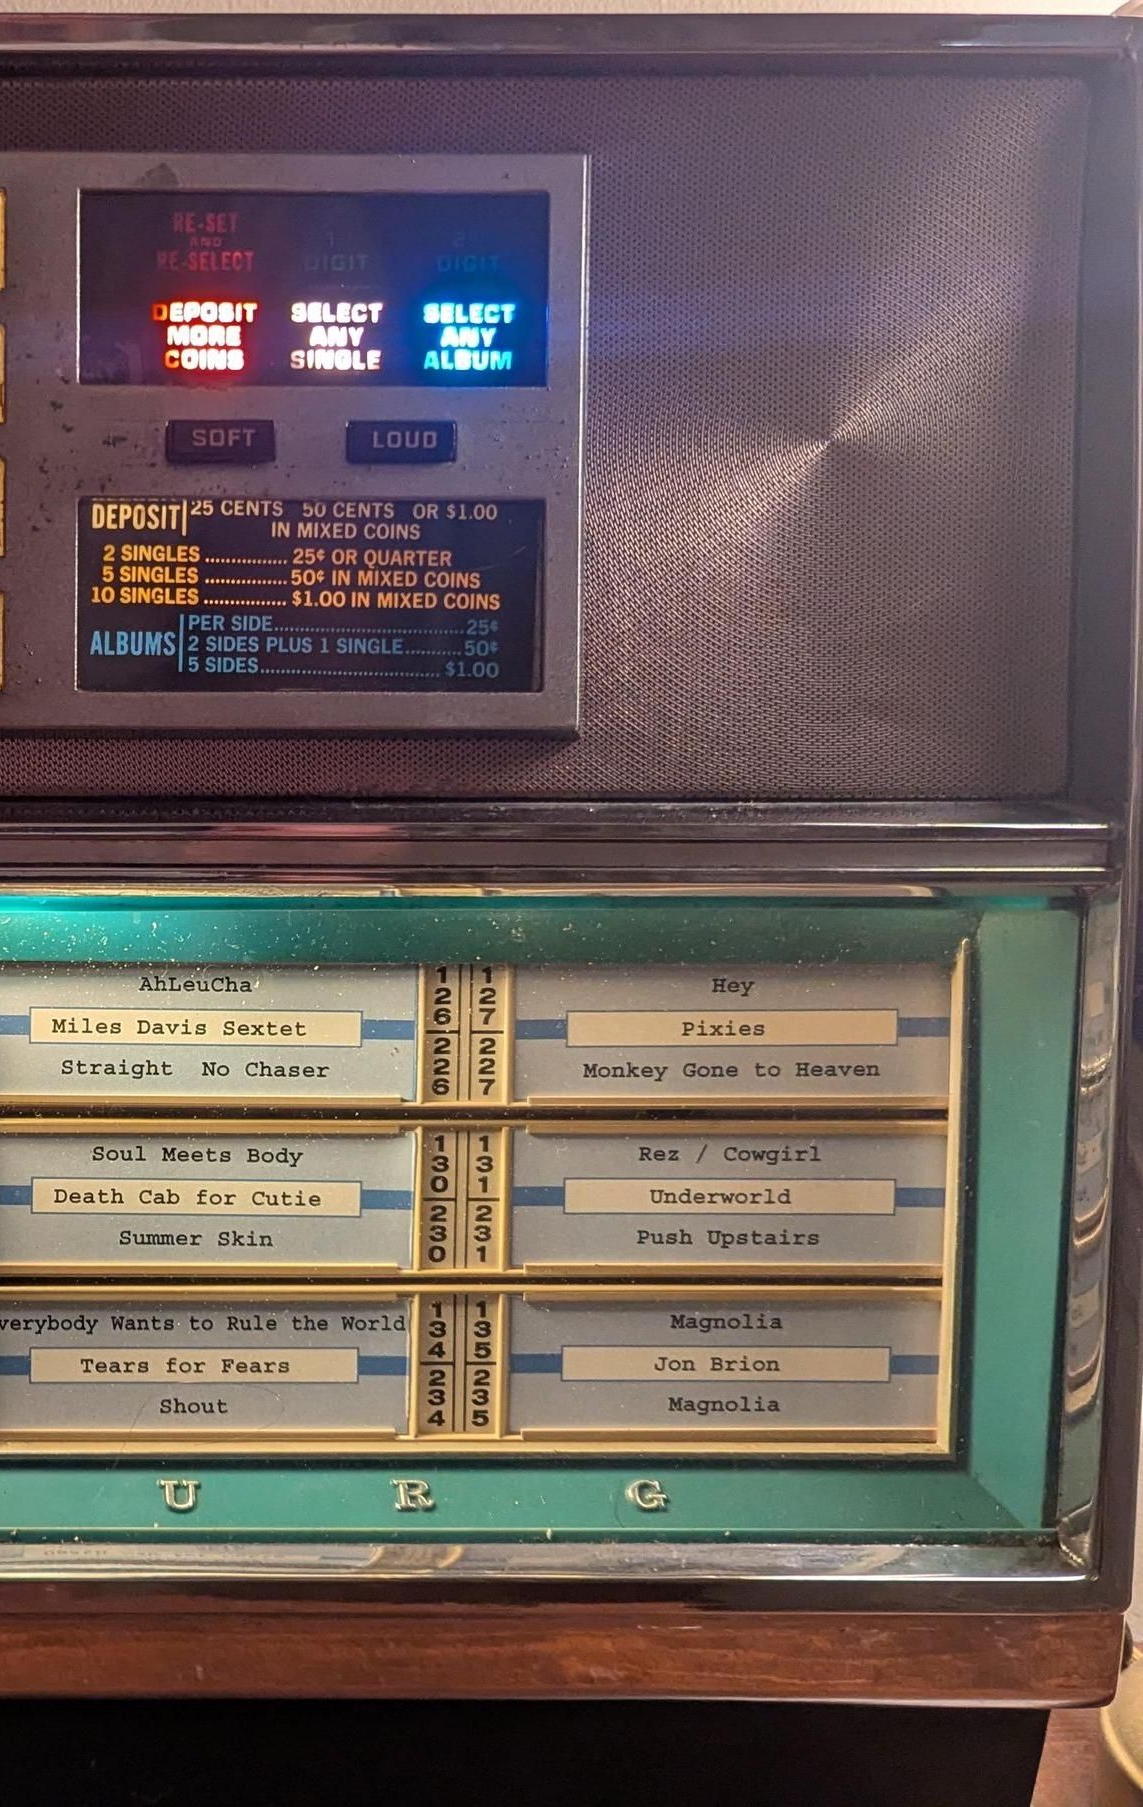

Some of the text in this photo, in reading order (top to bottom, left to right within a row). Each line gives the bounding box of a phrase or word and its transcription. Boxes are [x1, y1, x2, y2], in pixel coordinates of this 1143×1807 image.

[152, 302, 258, 322] DEPOSIT
[290, 302, 383, 323] SELECT
[423, 303, 515, 324] SELECT
[167, 325, 241, 346] MORE
[309, 328, 364, 345] ANY
[441, 328, 496, 346] ANY
[165, 349, 244, 370] COINS
[290, 351, 381, 369] SINGLE
[424, 352, 511, 369] ALBUM
[192, 430, 255, 447] SOFT
[373, 431, 437, 448] LOUD
[92, 504, 180, 529] DEPOSIT
[272, 522, 420, 540] IN MIXED COINS
[103, 545, 115, 560] 2
[121, 547, 200, 562] SINGLES
[332, 550, 358, 565] OR
[364, 551, 452, 568] QUARTER
[102, 568, 114, 582] 5
[120, 569, 199, 584] SINGLES
[332, 571, 350, 586] IN
[359, 571, 418, 587] MIXED
[424, 573, 480, 588] COINS
[91, 587, 500, 610] 10 SINGLES $1.00 IN MIXED COINS
[189, 615, 273, 632] PER SIDE
[90, 631, 176, 656] ALBUMS
[188, 637, 403, 655] 2 SIDES PLUS 1 SINGLE
[139, 977, 253, 993] AhLeuCha
[712, 978, 755, 997] Hey
[52, 1019, 307, 1037] Miles Davis Sextet
[682, 1021, 765, 1037] Pixies
[61, 1061, 330, 1079] Straight No Chaser
[584, 1061, 880, 1082] Monkey Gone to Heaven
[92, 1147, 303, 1167] Soul Meets Body
[638, 1147, 821, 1166] Rez Cowgirl
[54, 1188, 321, 1207] Death Cab for Cutie
[650, 1188, 791, 1206] Underworld
[119, 1231, 273, 1247] Summer Skin
[637, 1229, 819, 1249] Push Upstairs
[112, 1316, 175, 1332] Wants
[189, 1317, 214, 1332] to
[227, 1316, 277, 1332] Rule
[291, 1316, 329, 1332] the
[341, 1316, 407, 1332] World
[670, 1314, 783, 1333] Magnolia
[81, 1358, 291, 1375] Tears for Fears
[654, 1357, 780, 1373] Jon Brion
[159, 1398, 228, 1415] Shout
[668, 1397, 780, 1415] Magnolia
